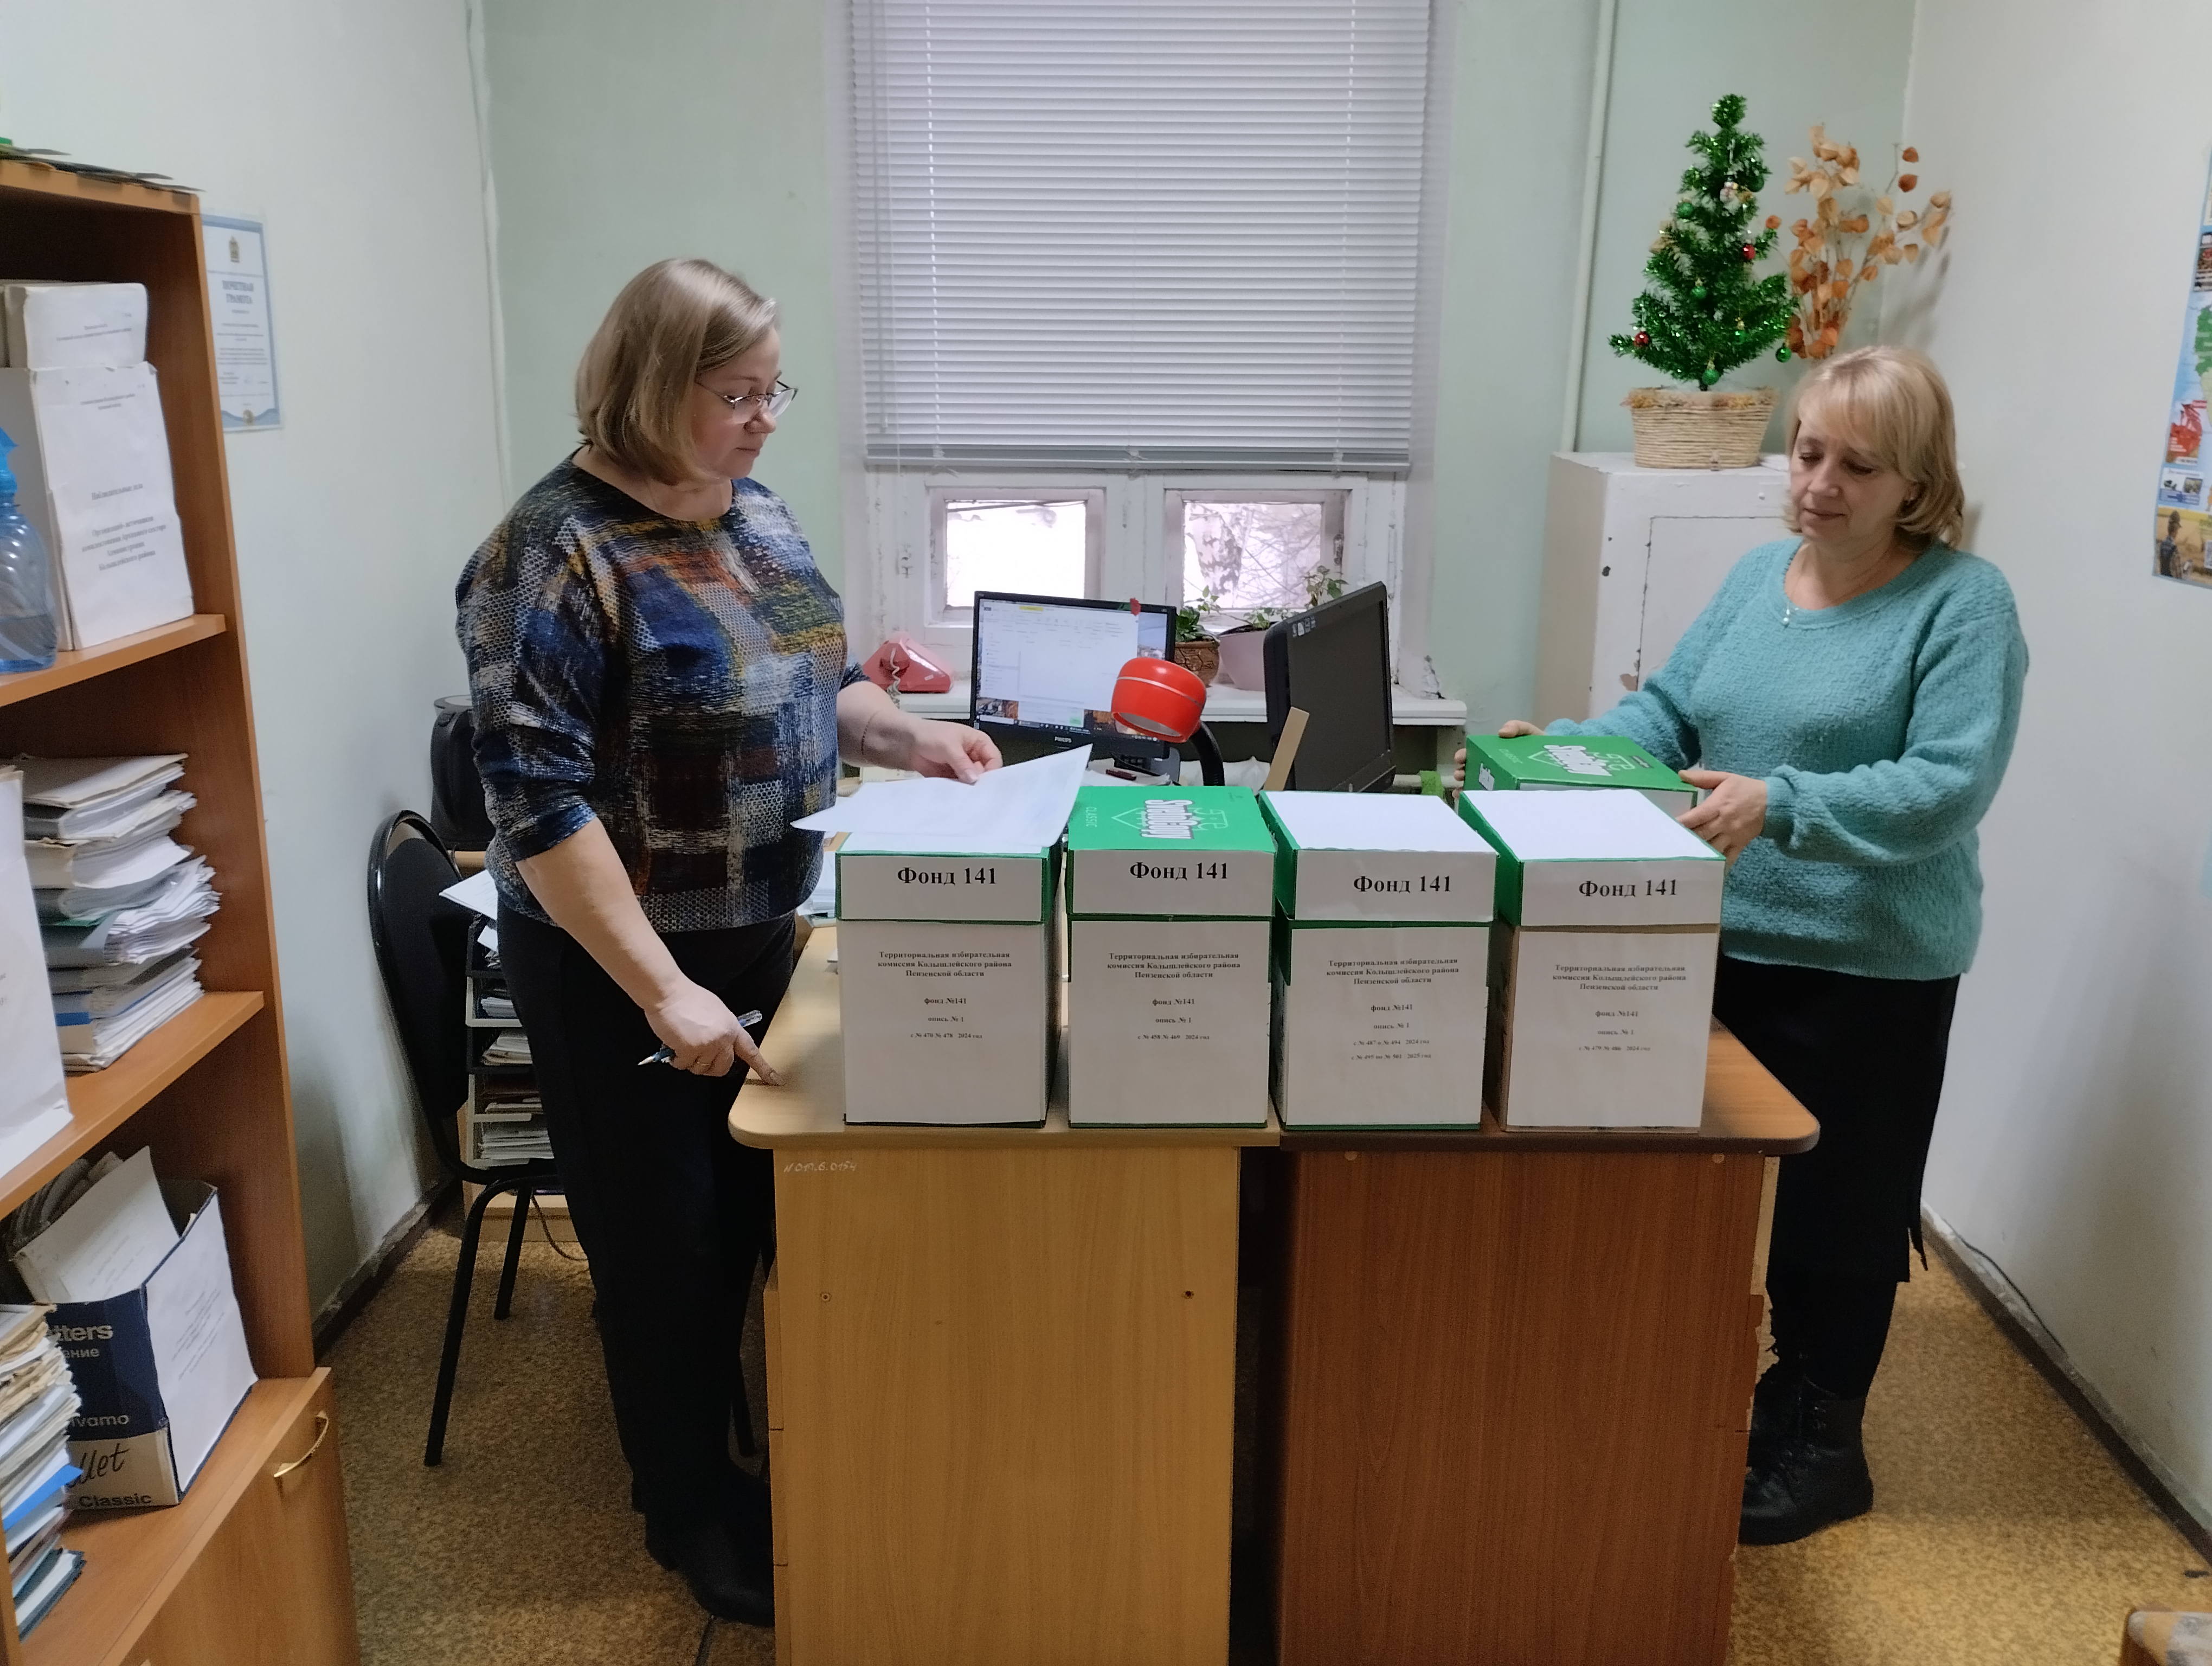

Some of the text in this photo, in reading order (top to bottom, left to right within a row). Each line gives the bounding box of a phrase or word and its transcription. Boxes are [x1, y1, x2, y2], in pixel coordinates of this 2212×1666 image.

[1085, 806, 1098, 828] CLASSIC
[1140, 799, 1199, 840] SvetoCopy
[897, 867, 996, 887] Фонд 141
[1130, 862, 1227, 880] Фонд 141
[1353, 875, 1451, 894] Фонд 141
[1578, 879, 1677, 898] Фонд 141
[879, 951, 1010, 959] Территориальная избирательная
[1109, 952, 1239, 962] Территориальная избирательная
[1213, 962, 1240, 970] района
[1328, 960, 1398, 968] Территориальная
[1152, 998, 1172, 1006] фонд
[79, 1493, 151, 1507] Classic
